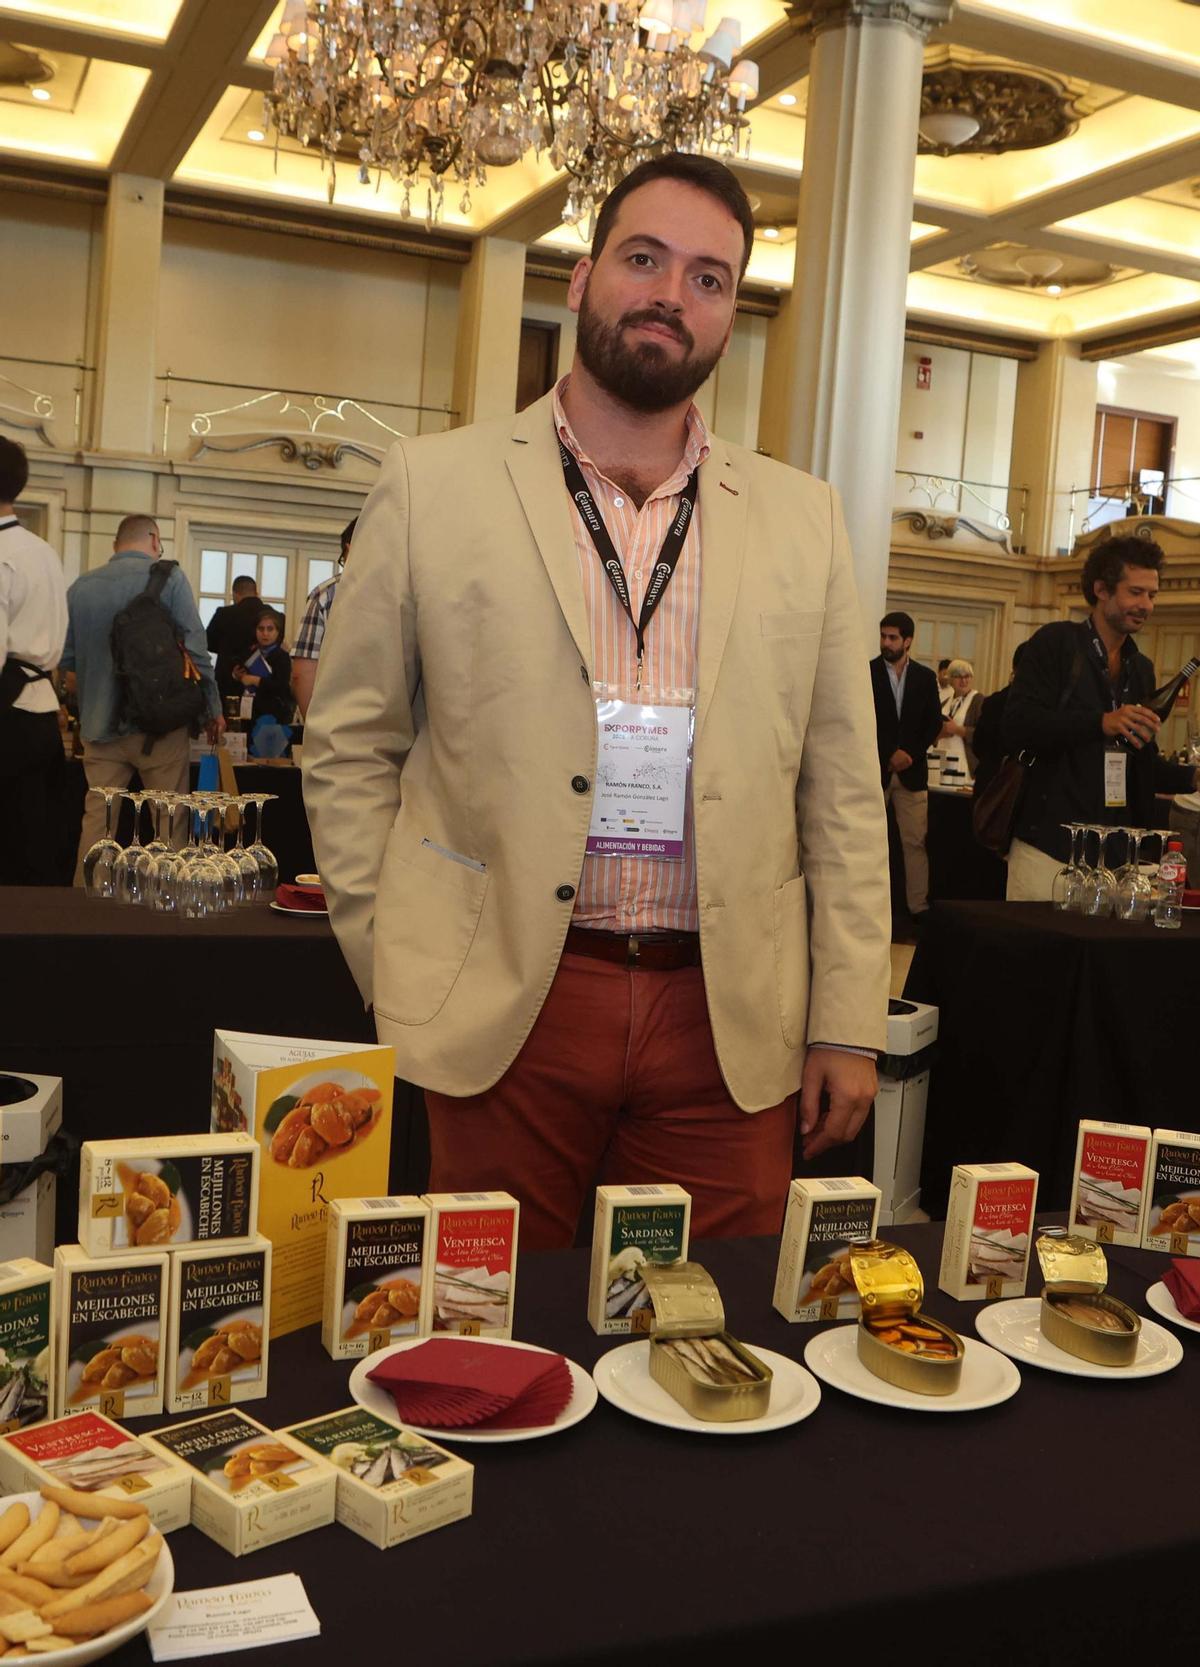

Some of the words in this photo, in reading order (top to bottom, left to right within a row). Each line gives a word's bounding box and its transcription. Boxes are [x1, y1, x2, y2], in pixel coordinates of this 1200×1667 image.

[575, 490, 600, 531] Cámara
[646, 562, 671, 606] Cámara
[604, 724, 668, 735] EXPORPYMES
[605, 781, 627, 789] RAMÓN
[596, 841, 636, 851] ALIMENTACIÓN
[636, 843, 641, 851] Y
[641, 843, 666, 852] BEBIDAS
[201, 1157, 212, 1172] EN
[1086, 1152, 1139, 1168] VENTRESCA
[1156, 1172, 1167, 1181] EN
[211, 1159, 224, 1234] MEJILLONES
[311, 1171, 329, 1204] R
[198, 1175, 211, 1239] ESCABECHE
[979, 1203, 1026, 1213] VENTRESCA
[621, 1227, 674, 1239] SARDINAS
[813, 1221, 869, 1233] MEJILLONES
[442, 1236, 506, 1248] VENTRESCA
[809, 1233, 820, 1242] EN
[351, 1242, 418, 1258] MEJILLONES
[347, 1258, 362, 1268] EN
[364, 1253, 421, 1267] ESCABECHE
[185, 1280, 259, 1302] MEJILLONES
[76, 1293, 155, 1312] MEJILLONES
[182, 1300, 197, 1311] EN
[199, 1291, 262, 1309] ESCABECHE
[72, 1312, 89, 1324] EN
[91, 1305, 158, 1322] ESCABECHE
[211, 1382, 226, 1401] R
[26, 1427, 107, 1453] VENTRESCA
[173, 1424, 249, 1450] MEJILLONES
[195, 1429, 261, 1451] ESCABECHE
[313, 1422, 376, 1444] SARDINAS
[247, 1504, 265, 1532] R
[393, 1498, 409, 1525] R
